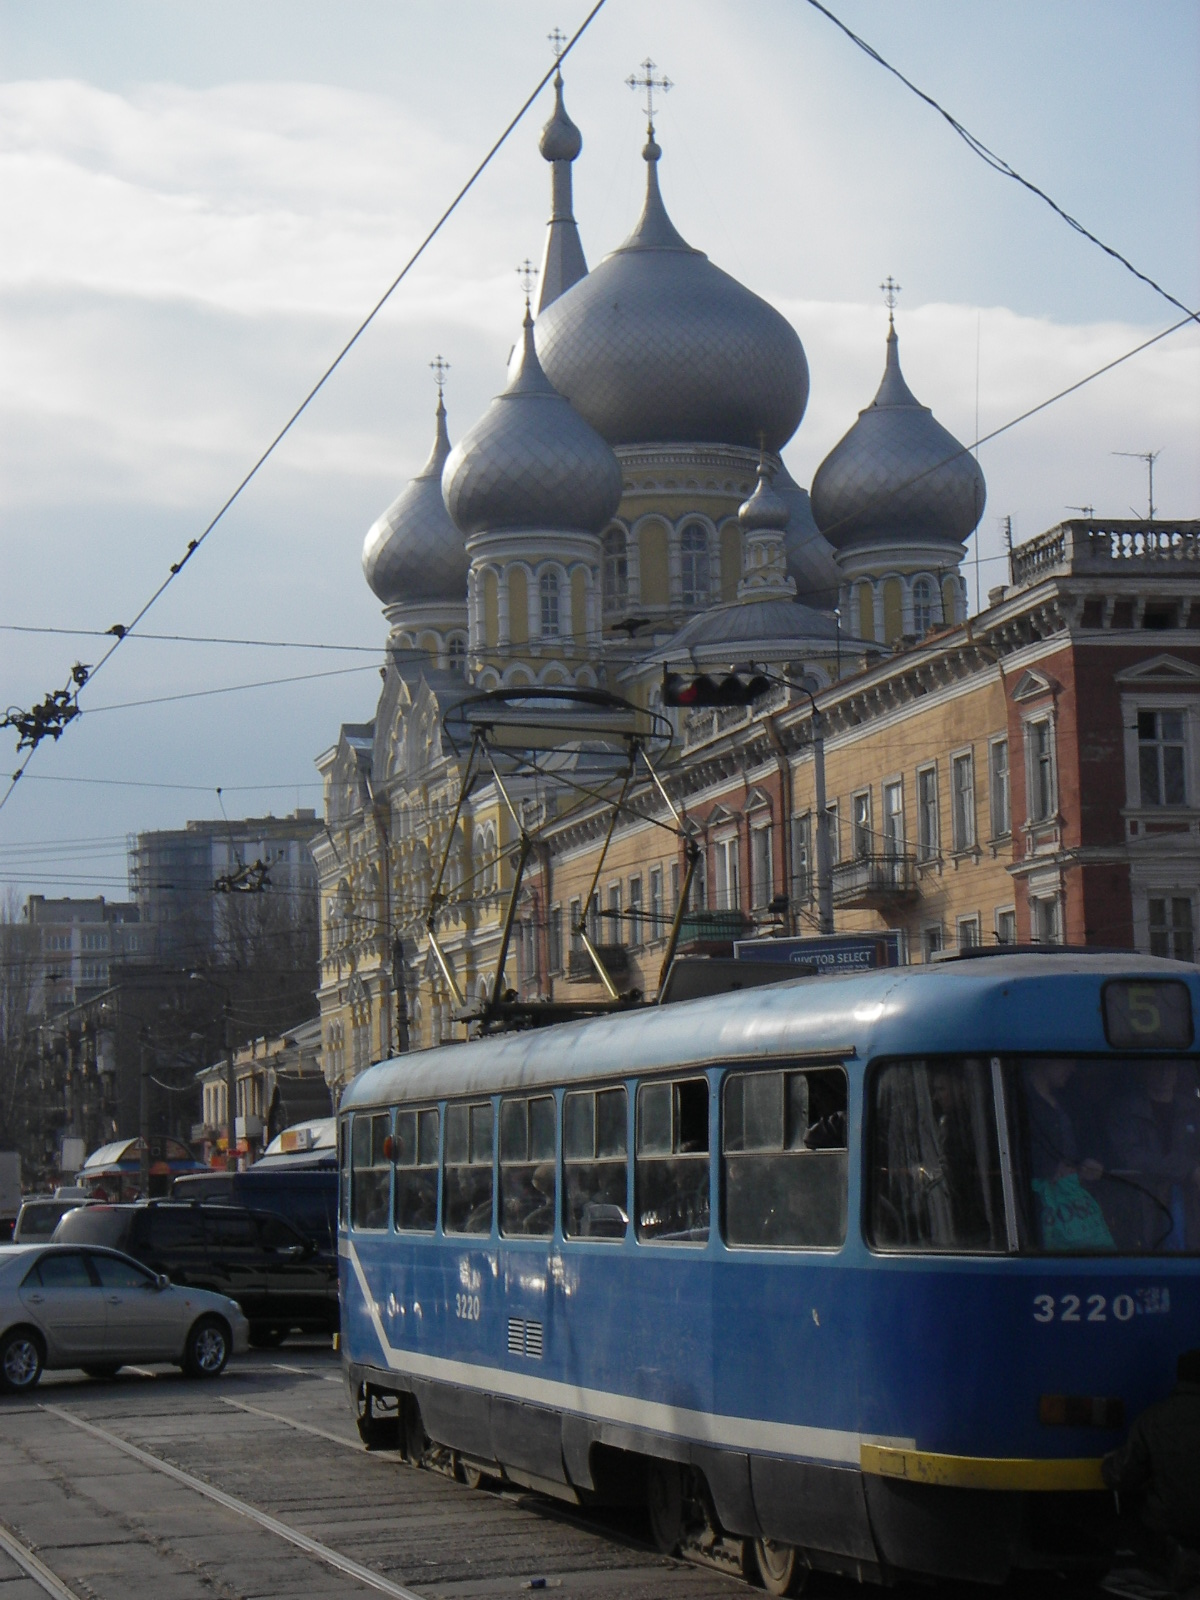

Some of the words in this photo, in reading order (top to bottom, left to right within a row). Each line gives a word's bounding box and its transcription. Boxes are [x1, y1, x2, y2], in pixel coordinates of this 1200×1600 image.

[837, 951, 871, 963] SELECT
[1129, 986, 1159, 1033] 5
[456, 1293, 480, 1320] 3220
[1033, 1294, 1135, 1322] 3220
